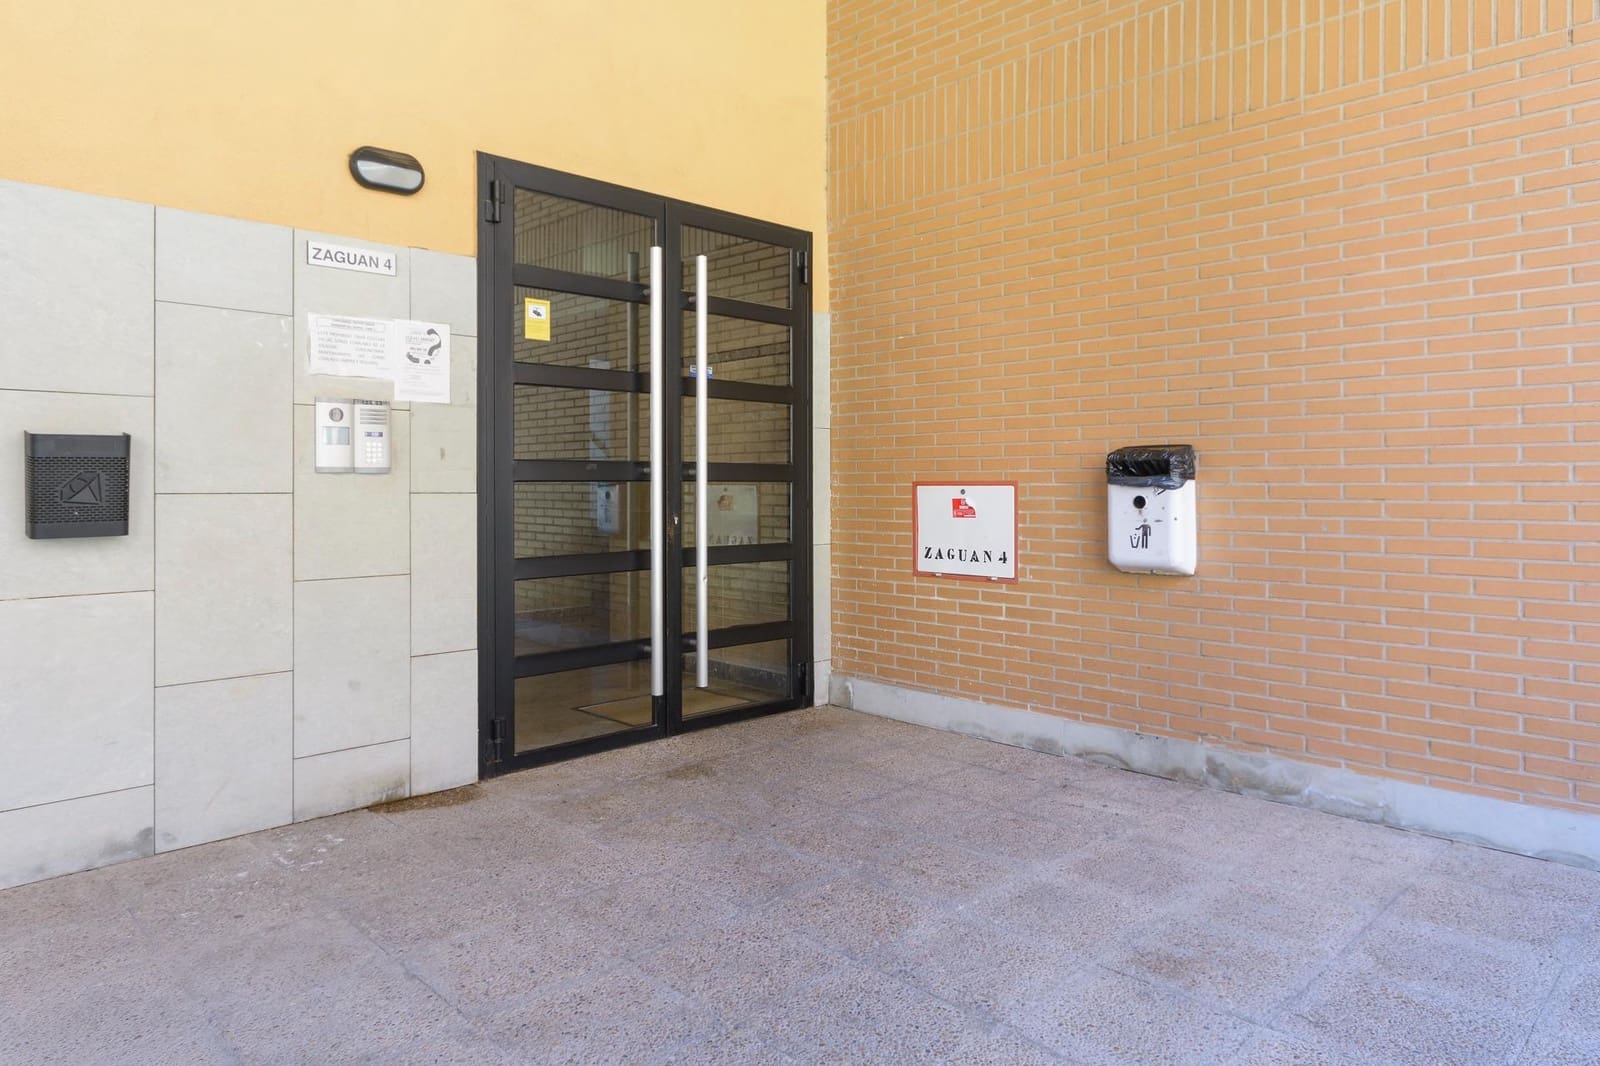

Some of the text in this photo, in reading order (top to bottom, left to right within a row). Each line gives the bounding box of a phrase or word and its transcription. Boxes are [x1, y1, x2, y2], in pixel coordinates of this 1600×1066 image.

[312, 247, 392, 271] ZAGUAN 4
[924, 546, 1007, 564] ZAGUAN 4
